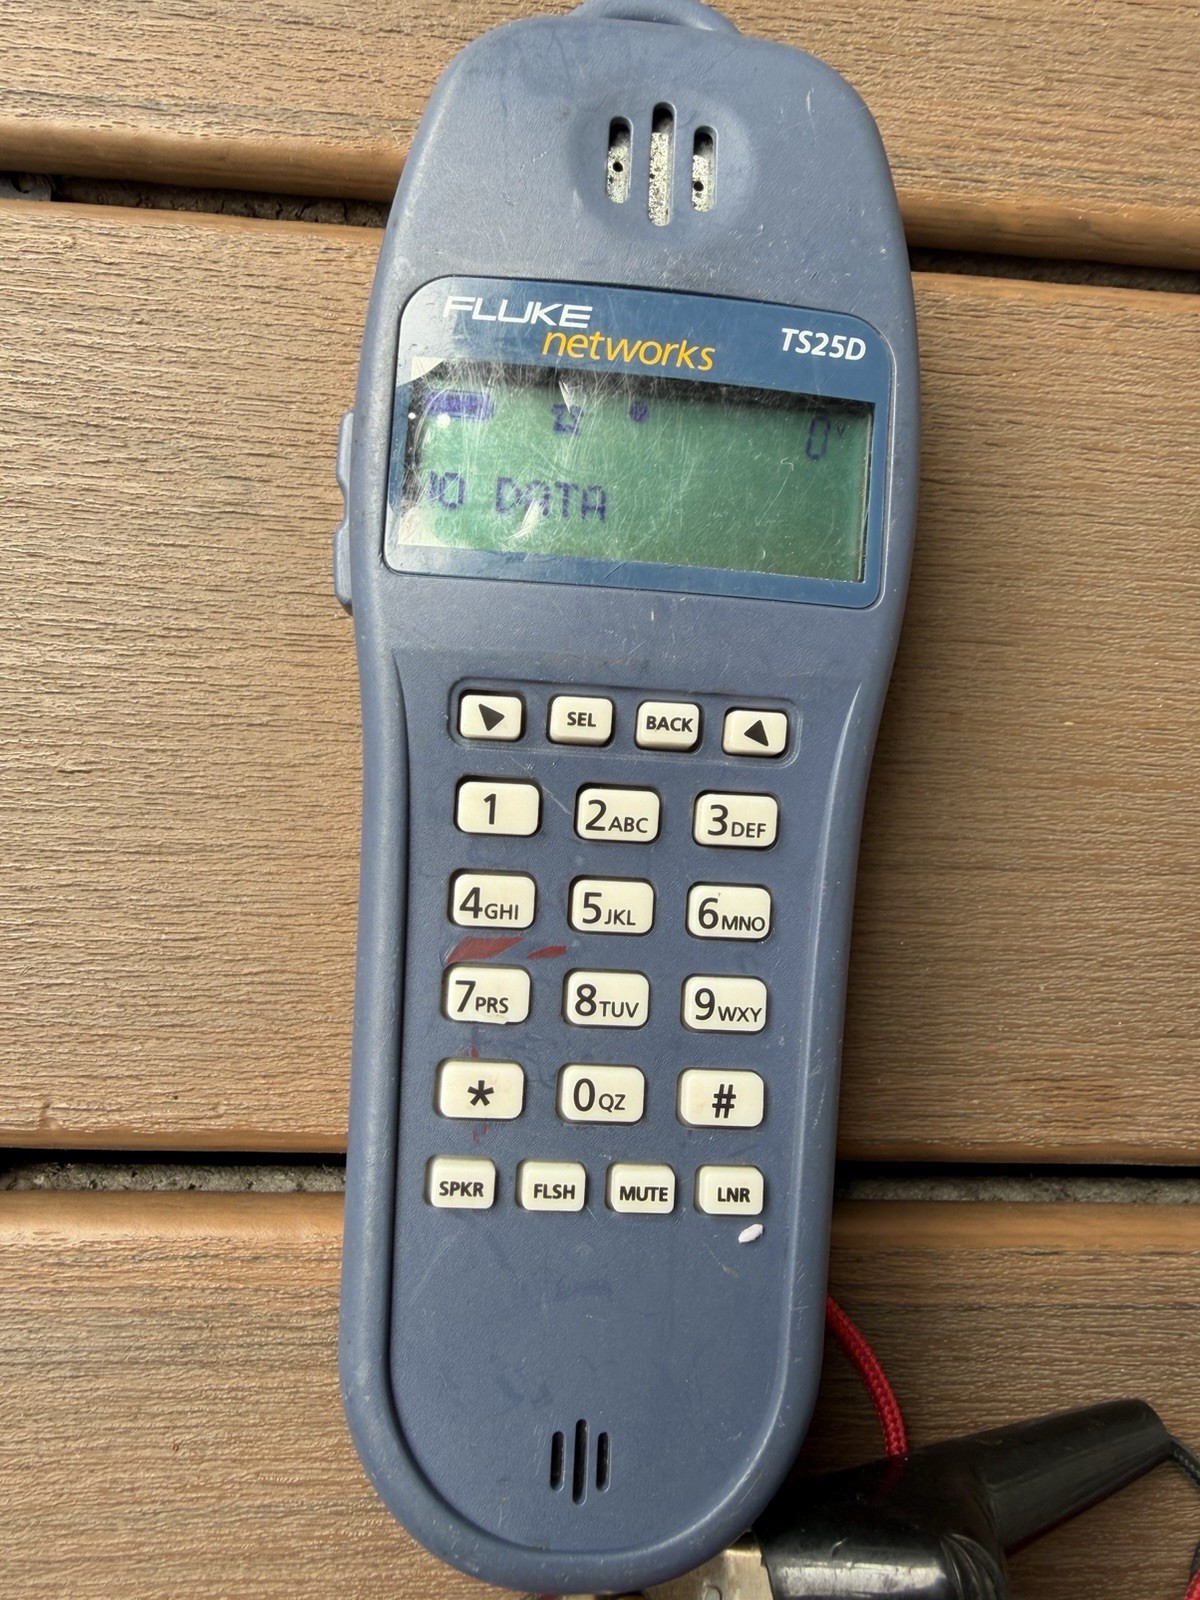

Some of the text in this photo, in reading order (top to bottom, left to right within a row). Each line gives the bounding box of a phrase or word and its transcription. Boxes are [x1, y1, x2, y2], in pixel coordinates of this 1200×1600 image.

[442, 295, 594, 329] FLUKE
[541, 331, 716, 371] networks
[781, 327, 867, 361] TS25D
[495, 477, 607, 521] DATA
[567, 711, 597, 728] SEL
[646, 715, 694, 733] BACK
[483, 793, 497, 825] 1
[711, 1083, 737, 1119] #
[439, 1181, 484, 1197] SPKR
[533, 1183, 576, 1200] FLSH
[619, 1185, 669, 1202] MUTE
[717, 1187, 751, 1203] LNR
